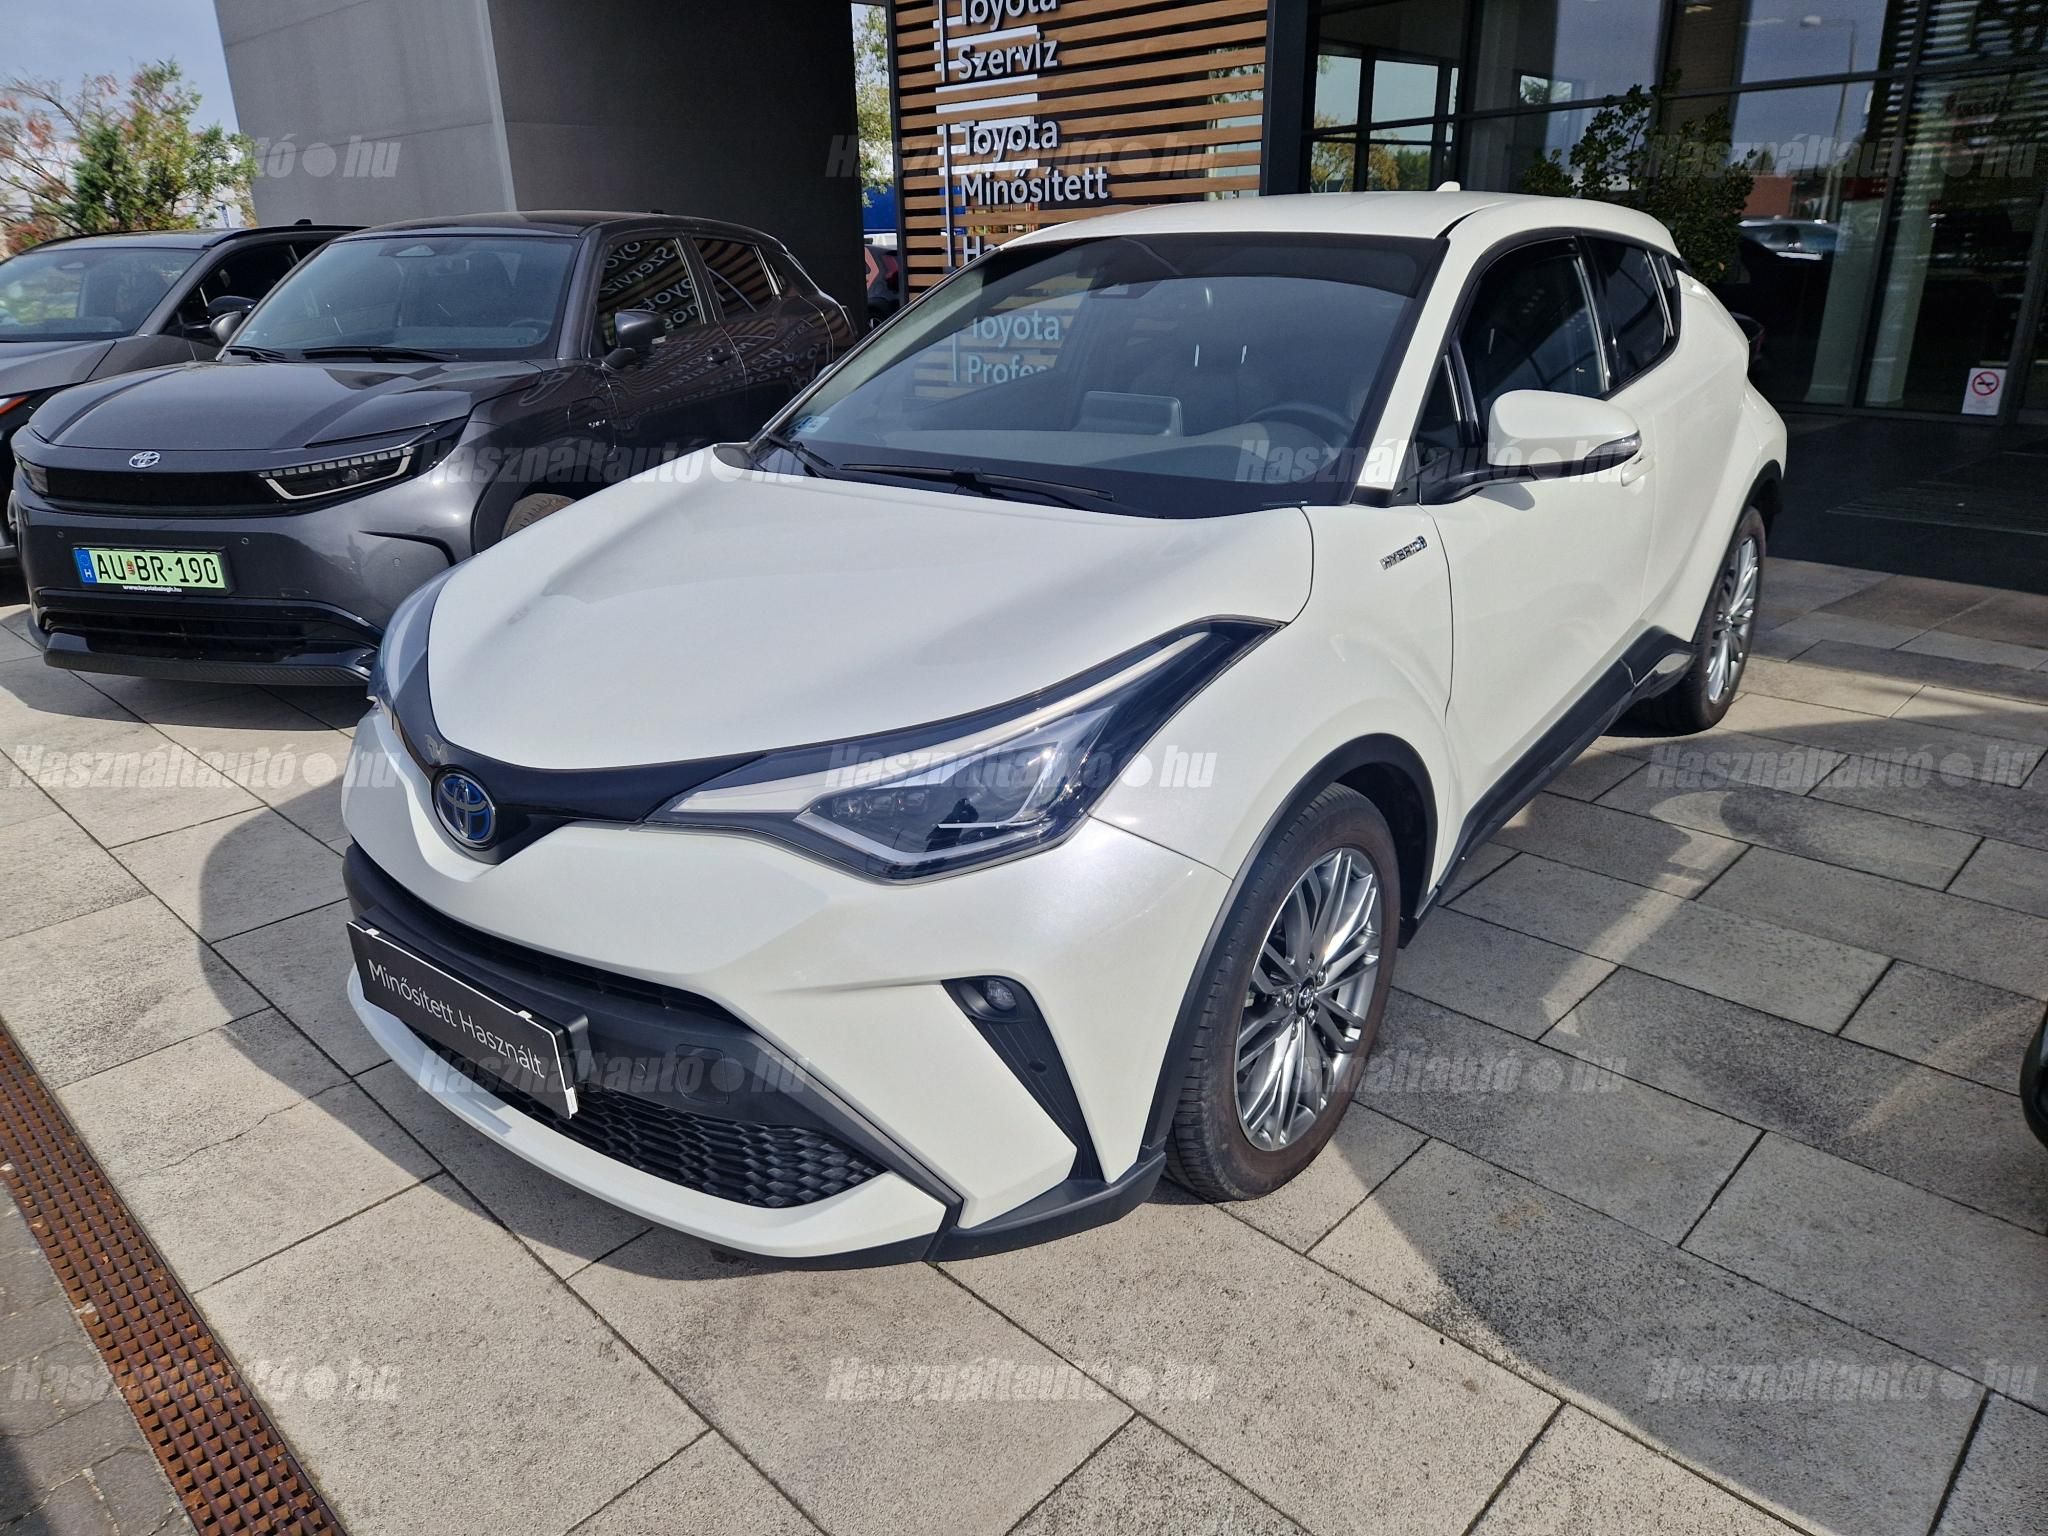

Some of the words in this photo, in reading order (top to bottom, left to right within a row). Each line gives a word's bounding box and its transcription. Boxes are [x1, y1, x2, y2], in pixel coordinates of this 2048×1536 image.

[958, 32, 1058, 79] Szerviz
[960, 119, 1058, 162] Toyota
[960, 166, 1109, 206] Minősített
[367, 958, 457, 1028] Minősített
[459, 1009, 545, 1079] Használt
